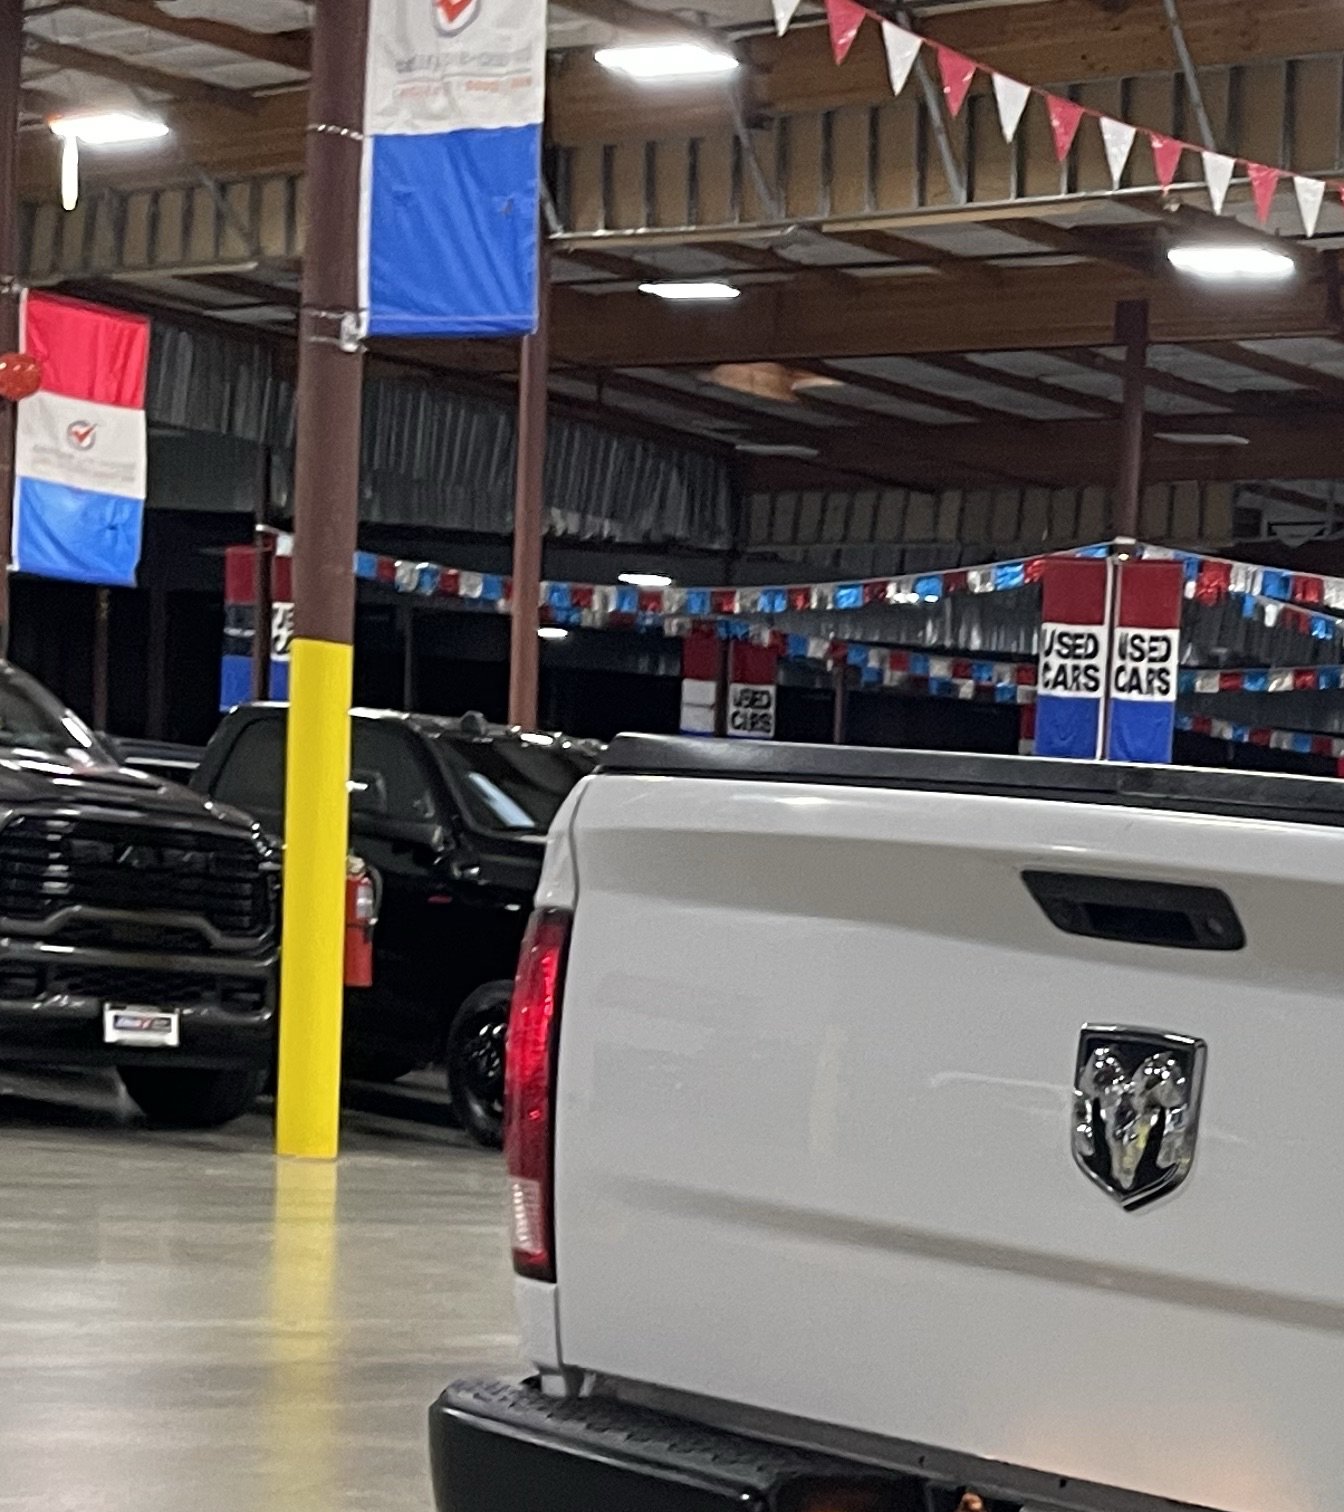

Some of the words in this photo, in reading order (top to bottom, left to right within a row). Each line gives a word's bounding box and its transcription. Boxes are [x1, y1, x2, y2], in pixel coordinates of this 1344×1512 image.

[1041, 629, 1099, 659] USED
[1042, 661, 1100, 692] CARS
[1115, 664, 1171, 695] CARS
